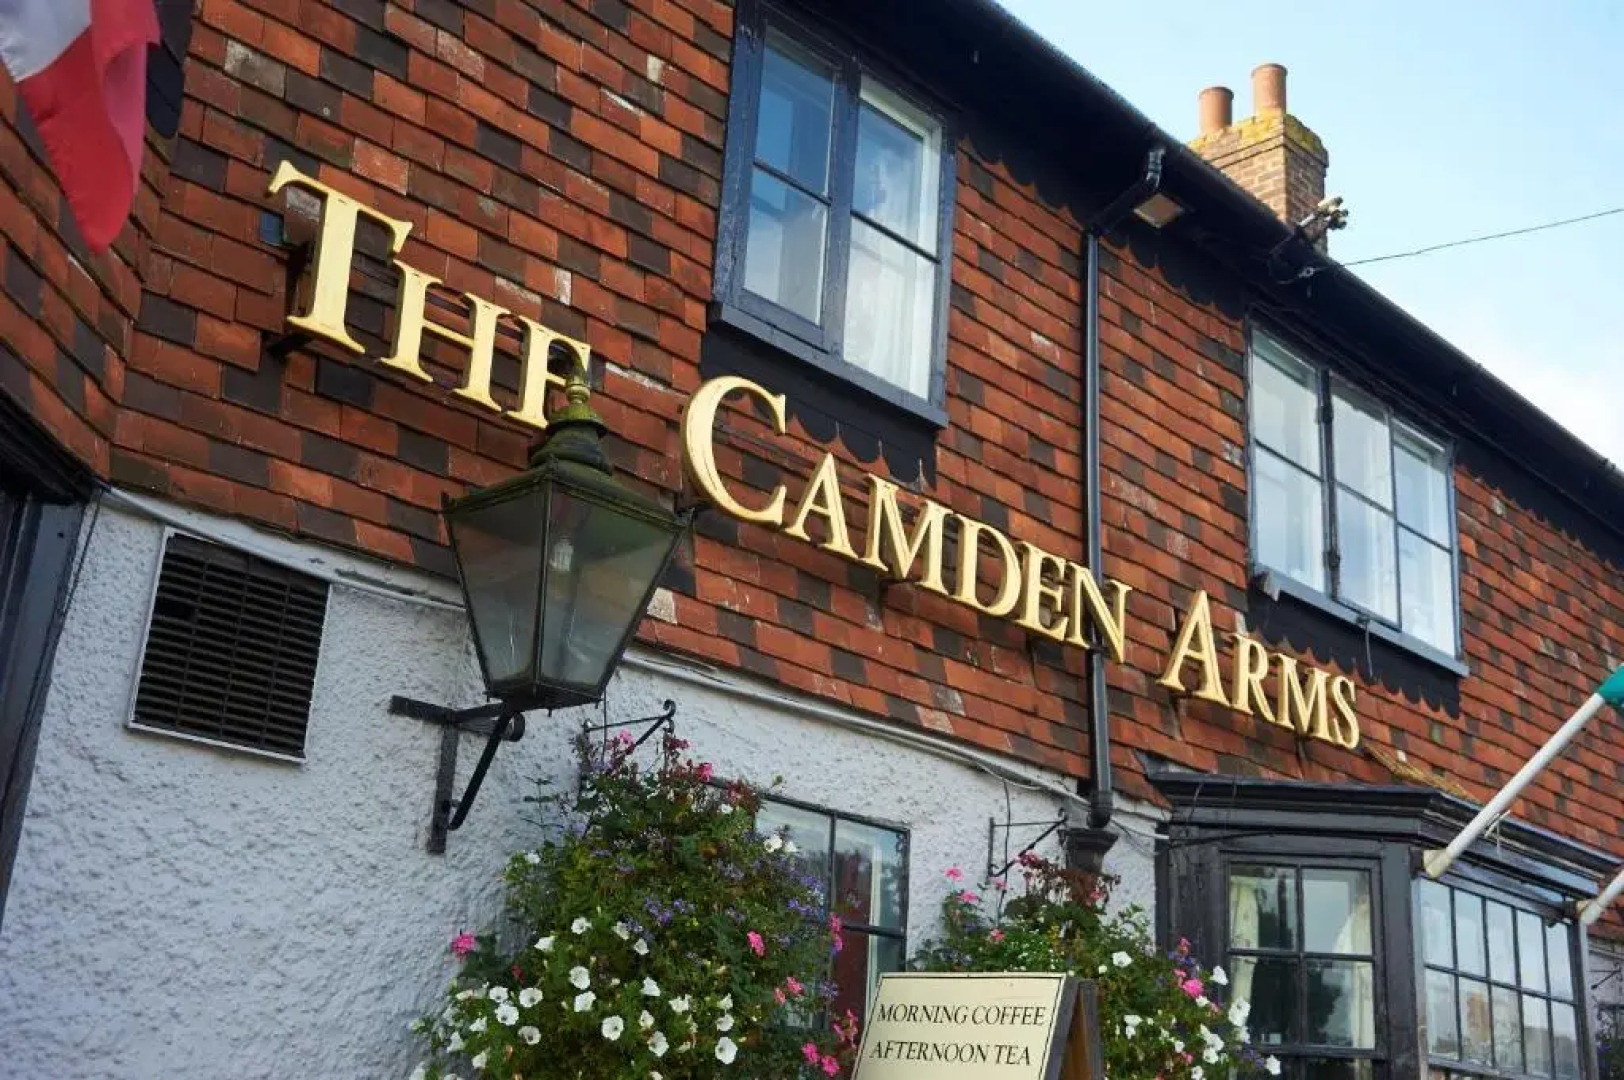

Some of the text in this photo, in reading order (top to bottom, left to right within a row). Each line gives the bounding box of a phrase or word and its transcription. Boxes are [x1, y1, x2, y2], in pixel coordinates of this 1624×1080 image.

[681, 375, 1133, 664] CAMDEN
[1155, 589, 1361, 750] ARMS
[877, 1003, 1046, 1026] MORNING COFFEE
[869, 1040, 1031, 1066] AFTERNOON TEA
